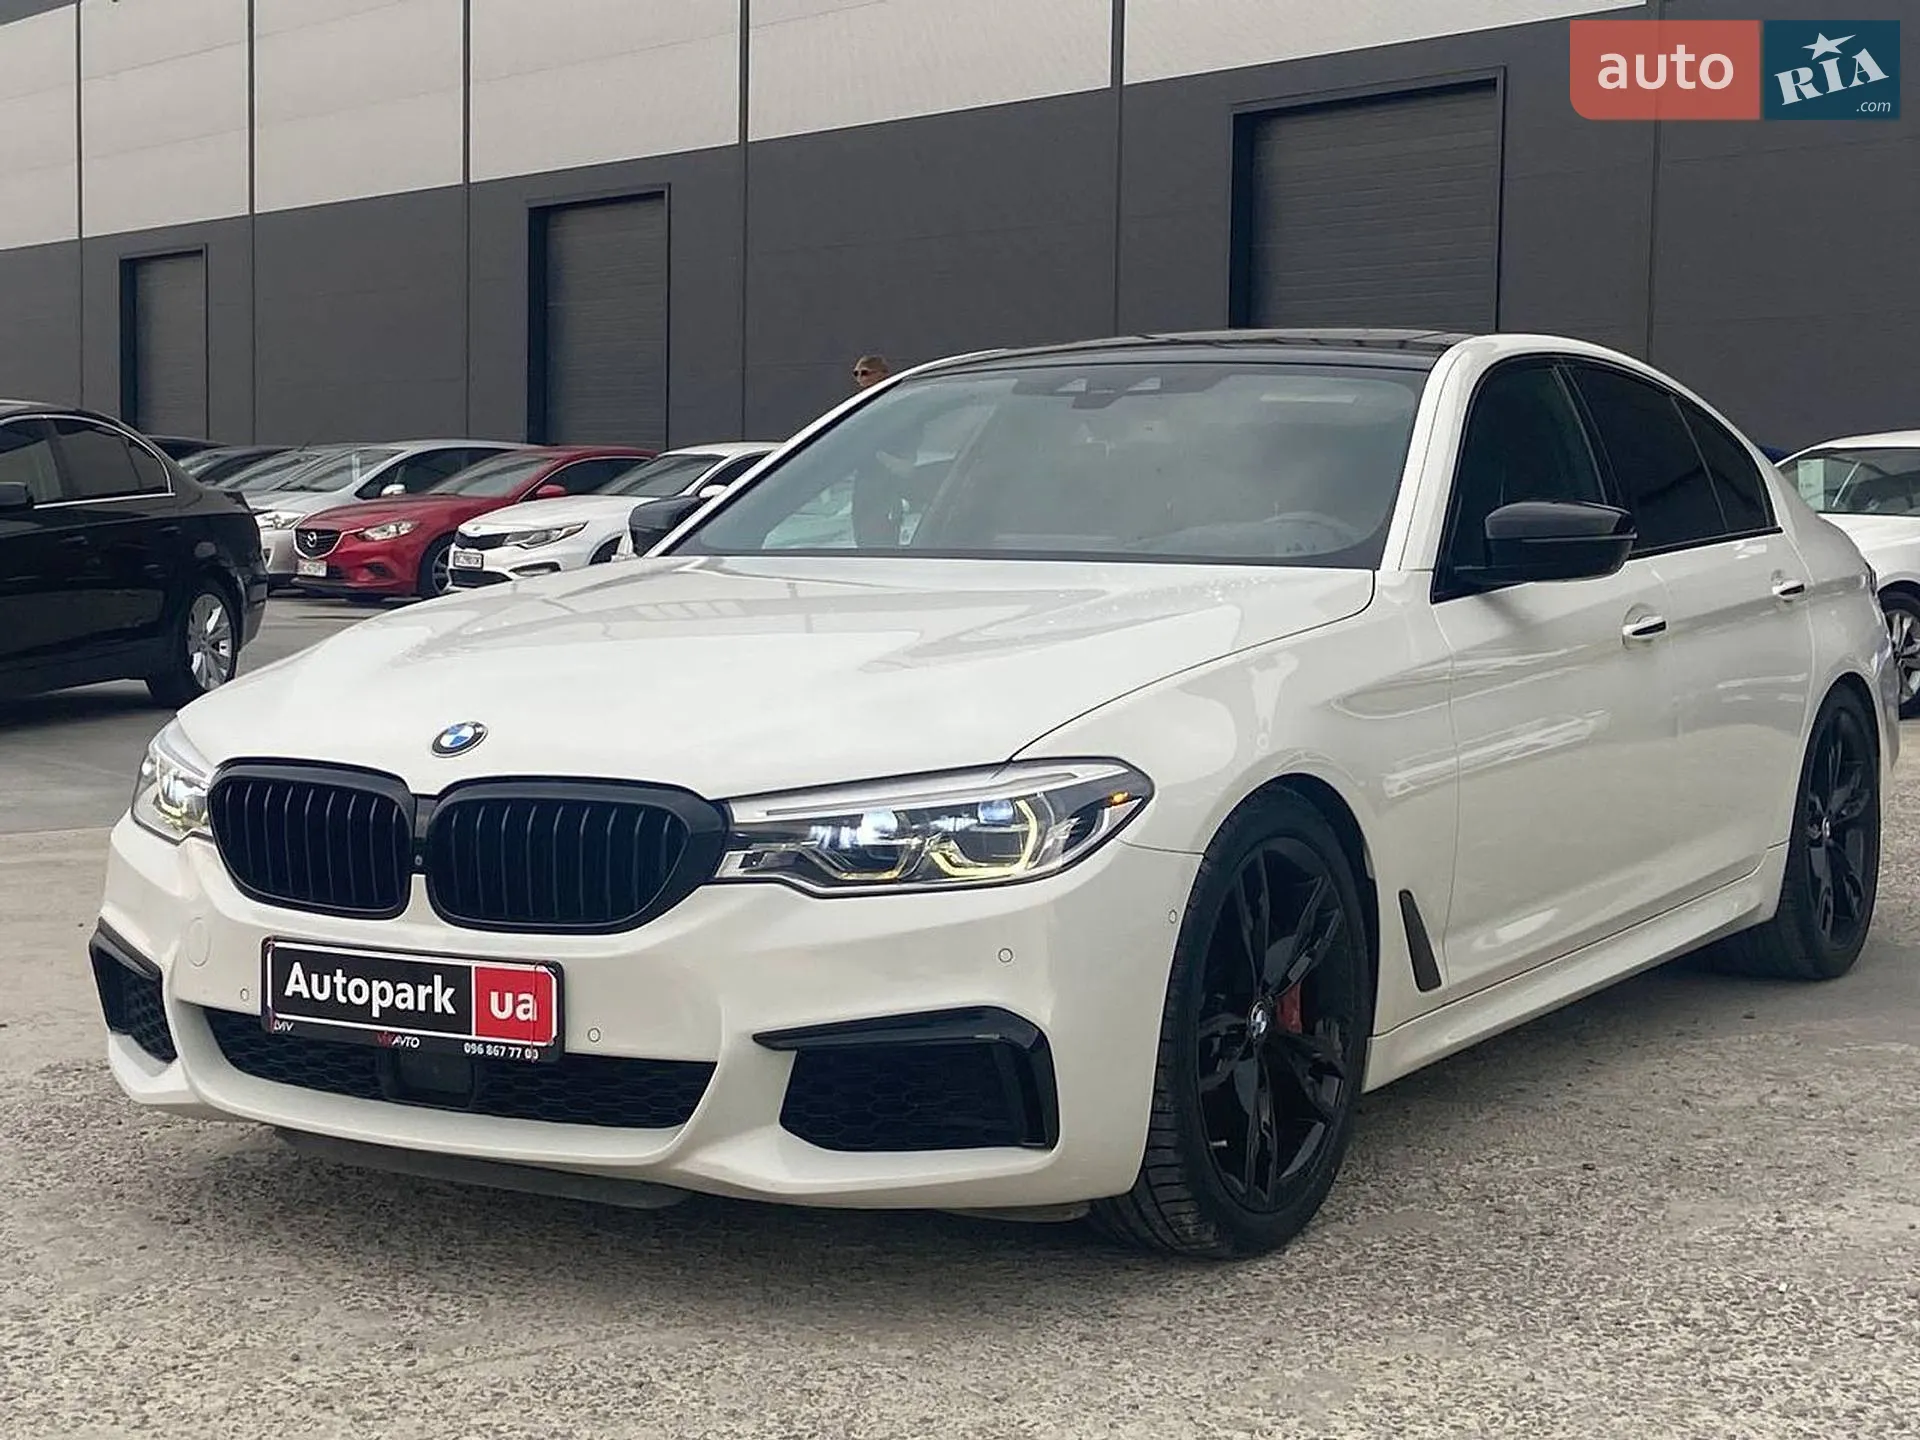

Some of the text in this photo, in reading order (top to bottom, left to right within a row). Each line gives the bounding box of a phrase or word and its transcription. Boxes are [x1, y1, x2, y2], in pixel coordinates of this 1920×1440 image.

[284, 961, 538, 1022] Autopark ua
[508, 1046, 523, 1059] 77
